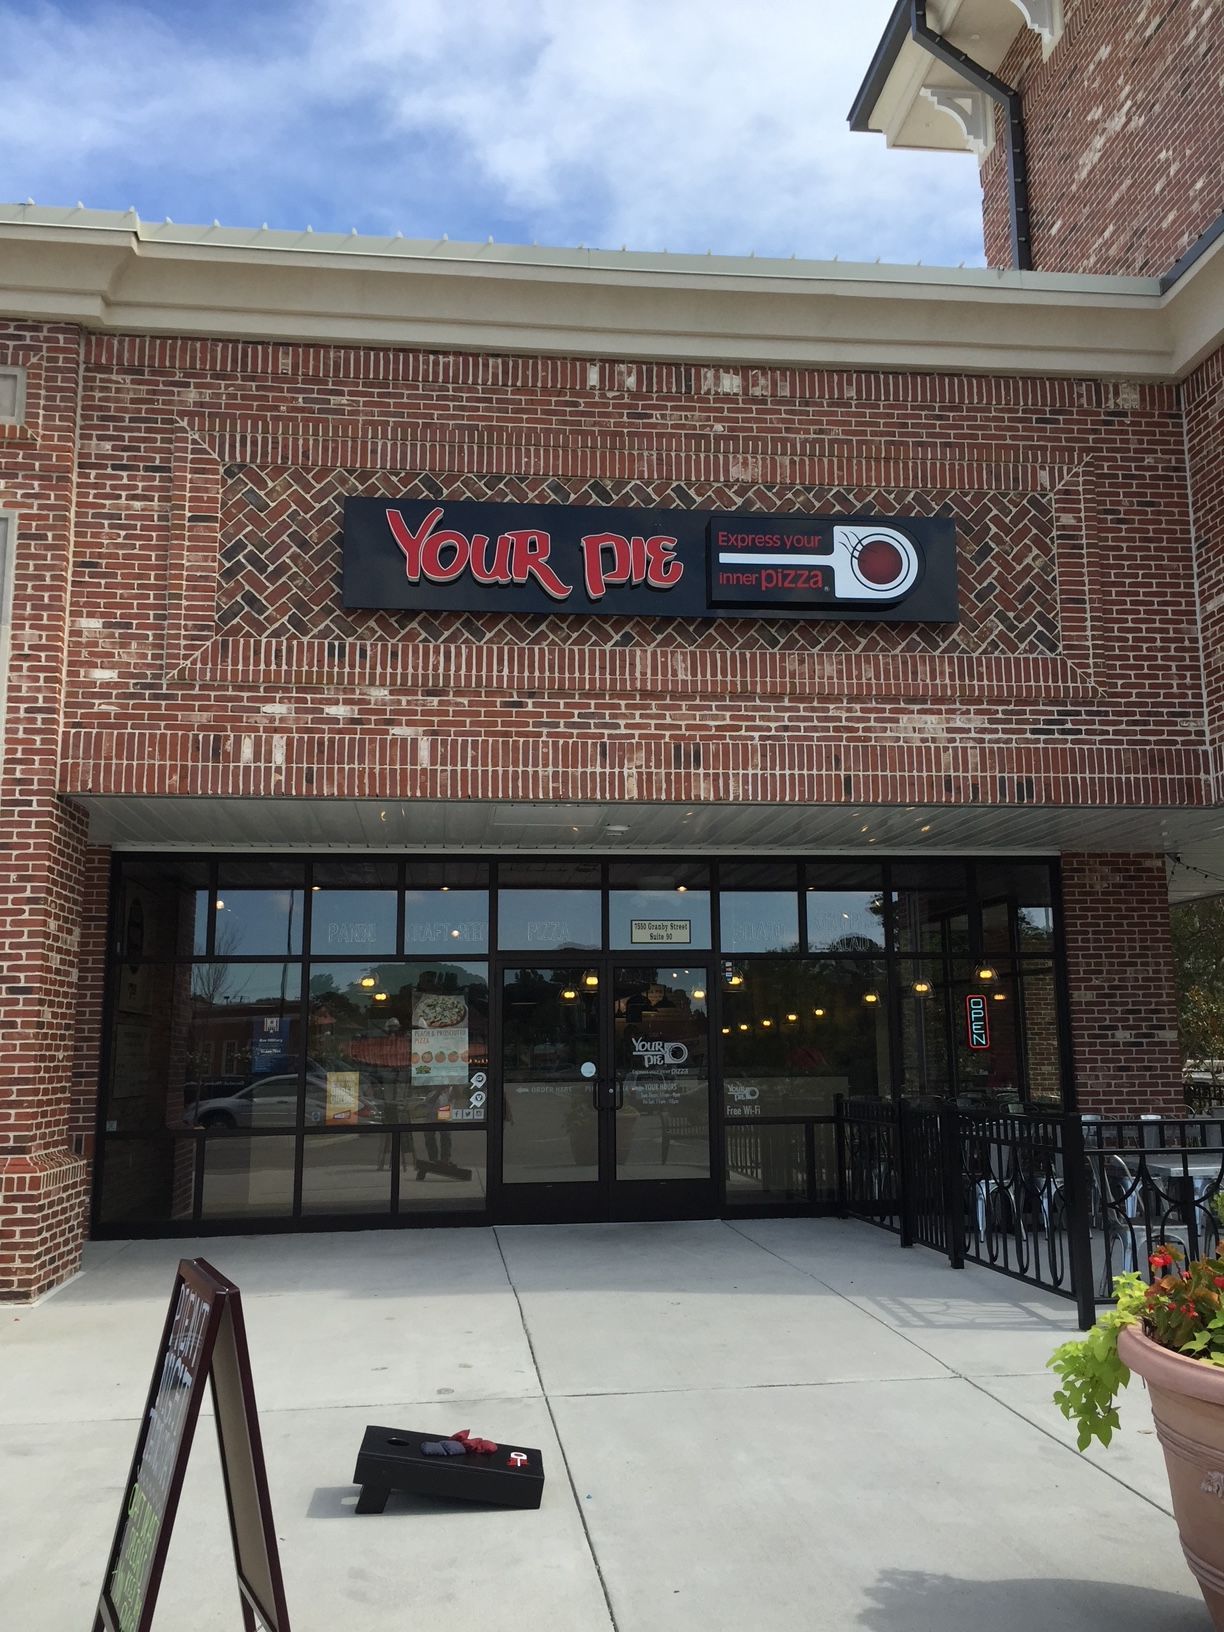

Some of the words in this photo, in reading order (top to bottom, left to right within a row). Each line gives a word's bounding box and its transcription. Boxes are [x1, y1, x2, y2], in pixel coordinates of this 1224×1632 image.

[718, 531, 781, 549] Express
[783, 534, 823, 549] your
[719, 571, 758, 585] inner
[761, 569, 823, 591] pizza
[970, 998, 986, 1045] OPEN
[727, 1105, 741, 1115] Free
[743, 1105, 760, 1115] Wi-Fi
